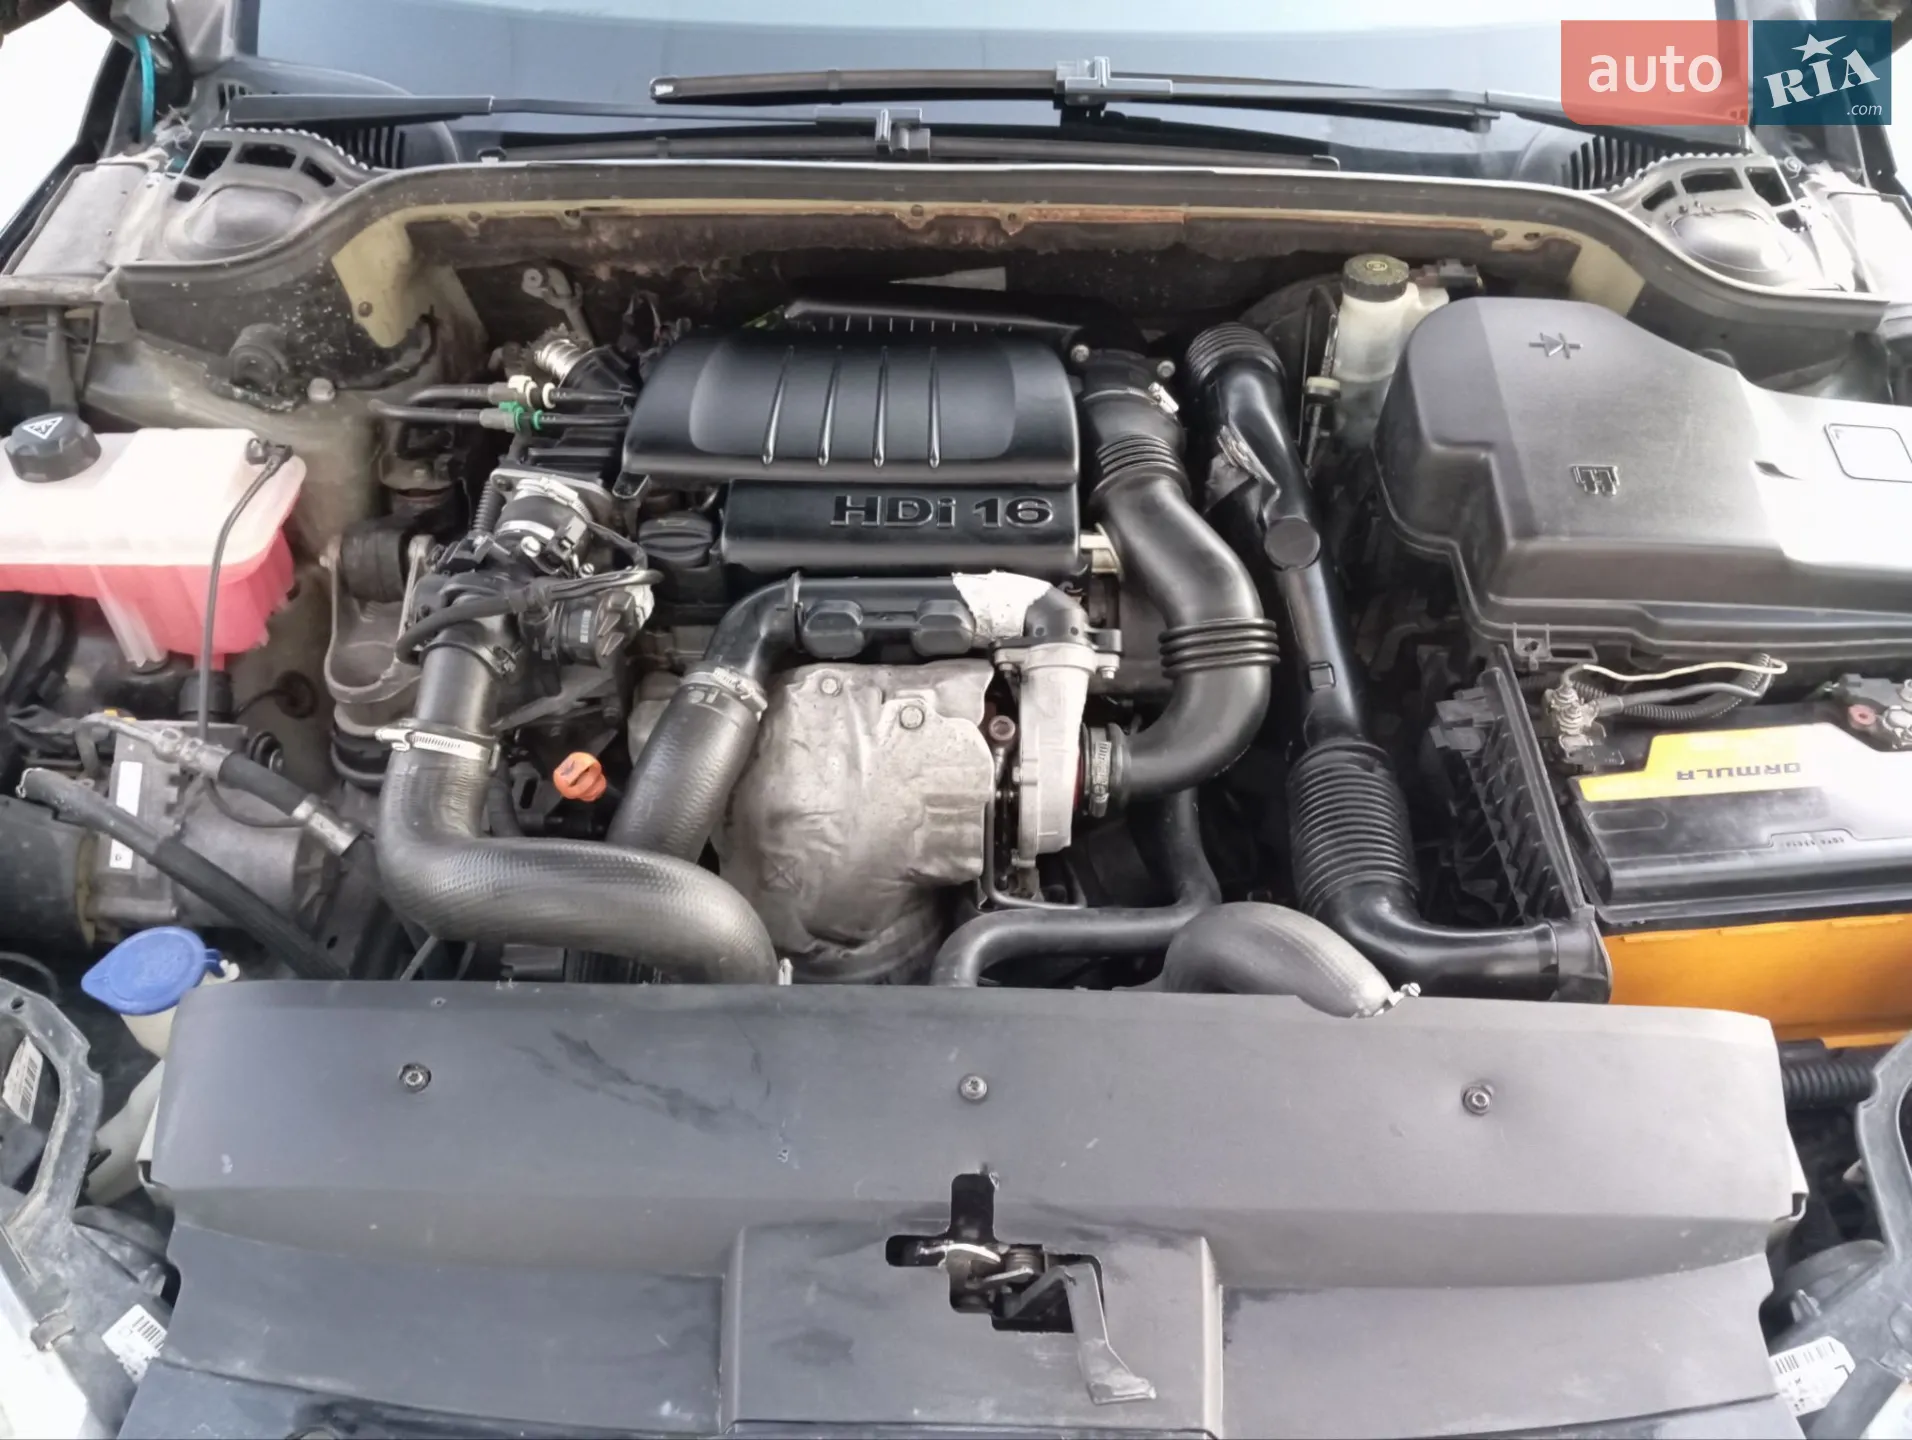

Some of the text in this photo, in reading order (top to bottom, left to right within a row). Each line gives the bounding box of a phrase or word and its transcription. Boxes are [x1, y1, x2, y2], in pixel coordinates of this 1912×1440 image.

[830, 495, 1054, 527] HDi 16
[1676, 762, 1802, 781] ORMULA
